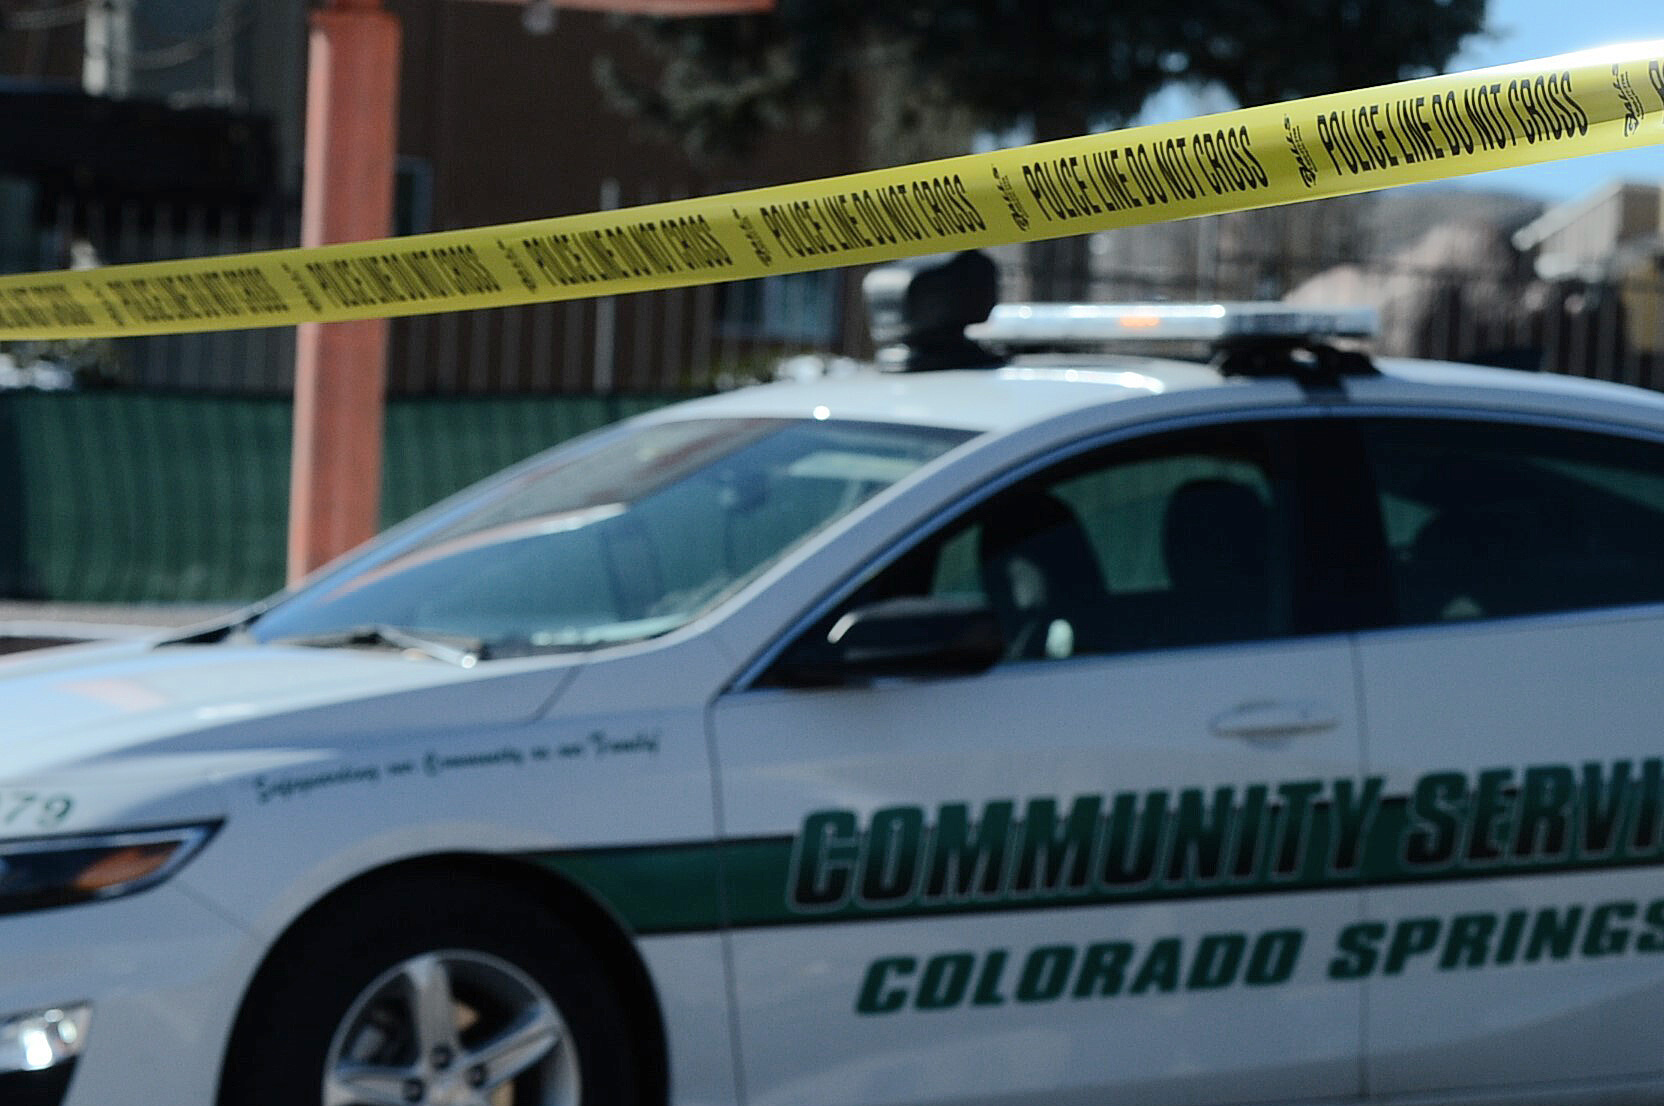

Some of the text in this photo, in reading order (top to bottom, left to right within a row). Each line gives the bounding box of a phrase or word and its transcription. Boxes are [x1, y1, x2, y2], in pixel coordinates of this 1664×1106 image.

[1317, 105, 1399, 175] POLICE
[1386, 97, 1444, 164] LINE
[1433, 91, 1475, 156] DO
[1463, 83, 1517, 150] NOT
[1508, 71, 1588, 145] CROSS
[760, 201, 836, 258] POLICE
[814, 194, 873, 250] LINE
[852, 189, 897, 245] DO
[877, 184, 931, 241] NOT
[912, 174, 986, 237] CROSS
[1022, 156, 1102, 221] POLICE
[1083, 149, 1142, 212] LINE
[1125, 143, 1168, 205] DO
[1153, 138, 1205, 201] NOT
[1193, 126, 1268, 195] CROSS
[788, 775, 1387, 912] COMMUNITY
[855, 928, 1306, 1017] COLORADO
